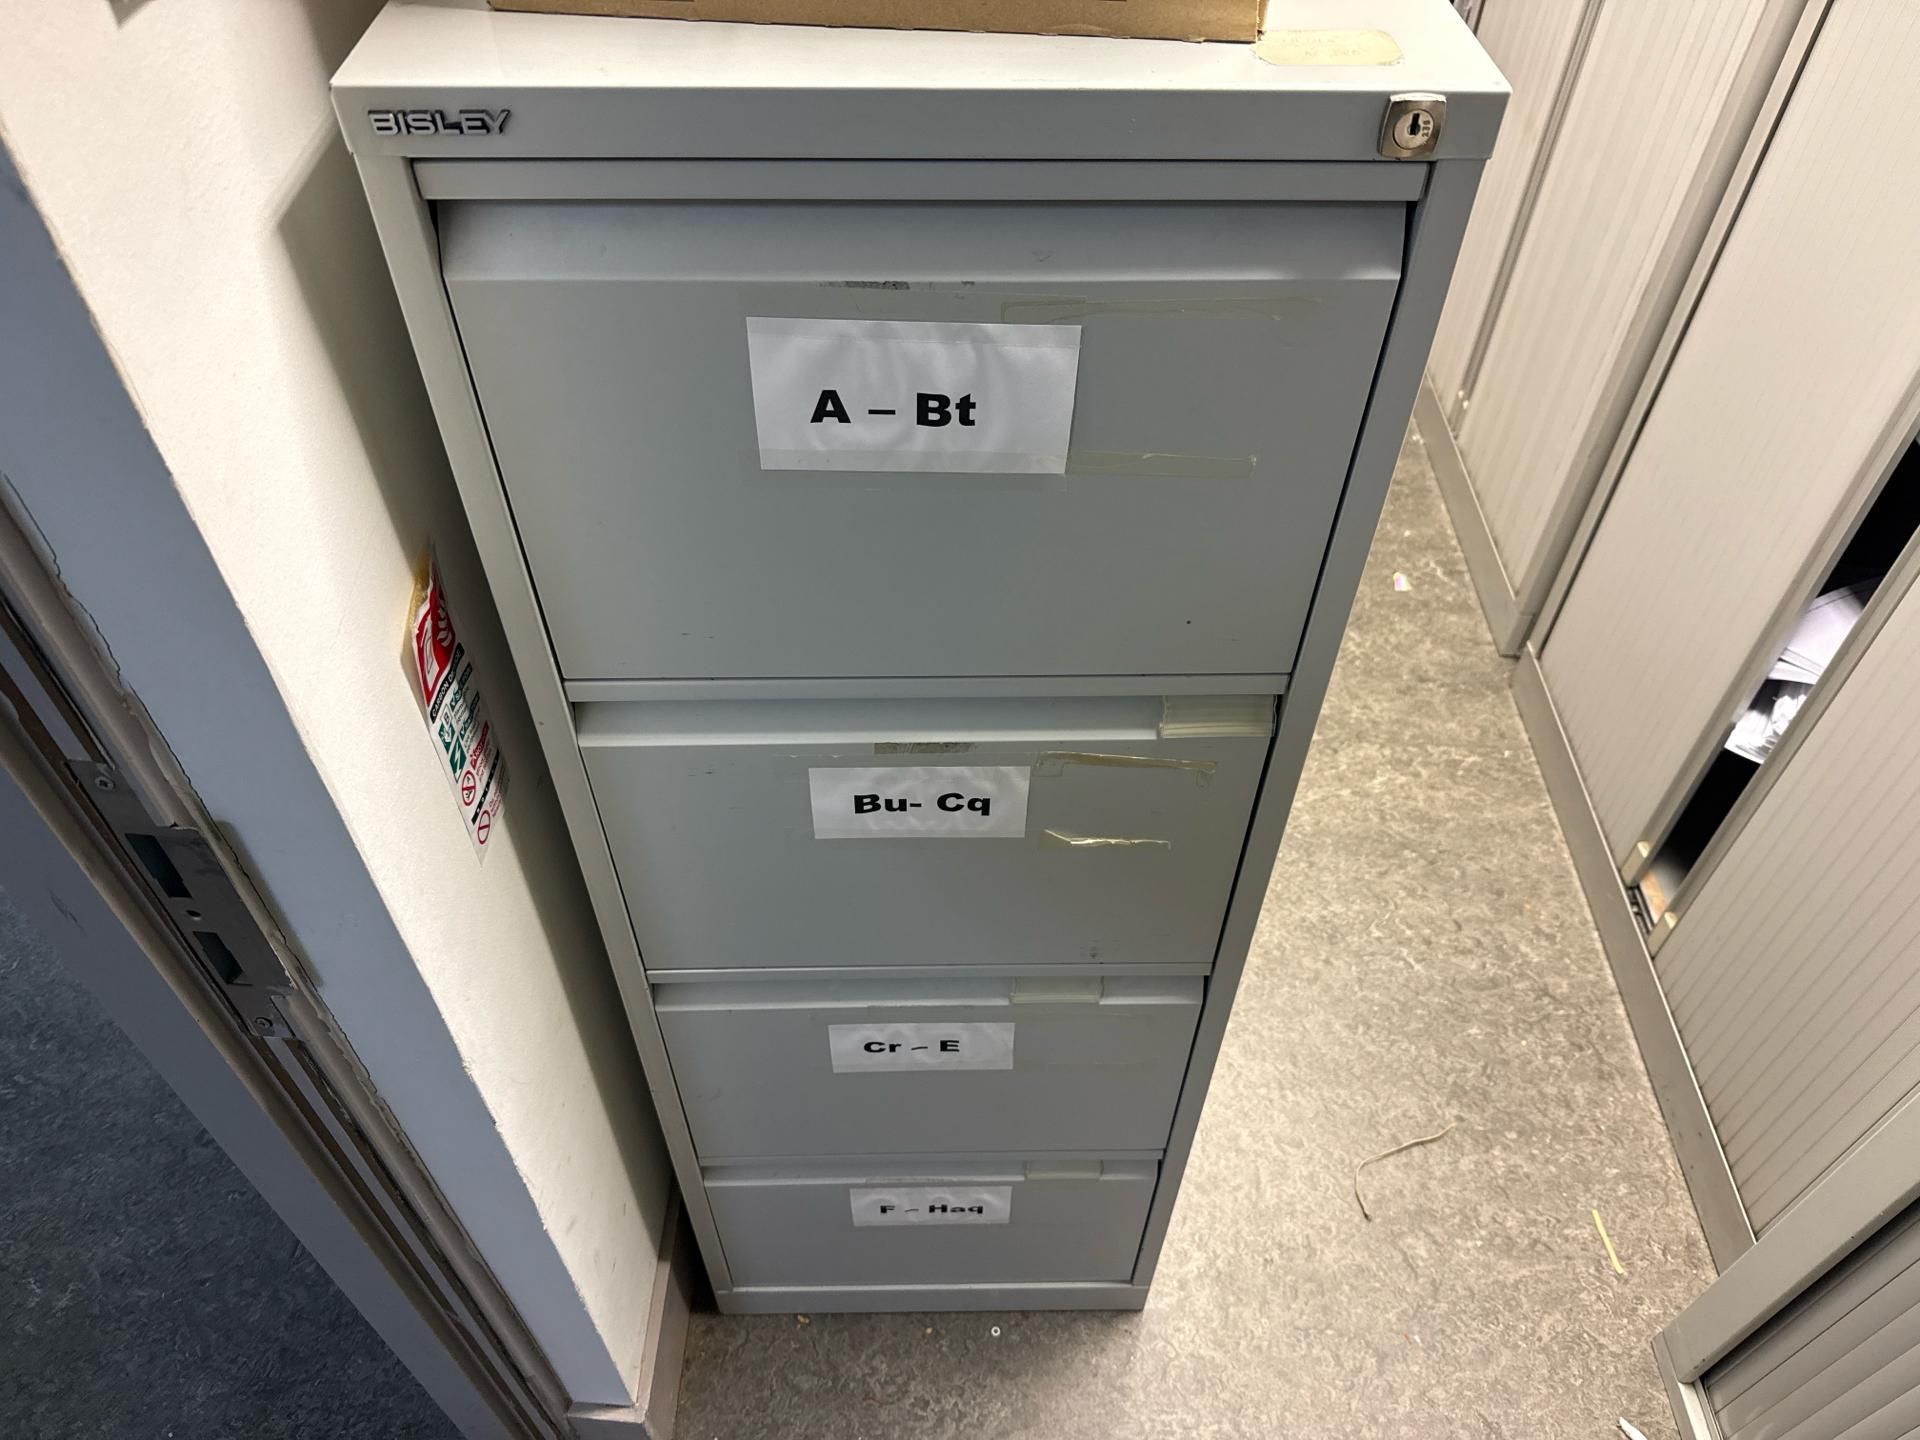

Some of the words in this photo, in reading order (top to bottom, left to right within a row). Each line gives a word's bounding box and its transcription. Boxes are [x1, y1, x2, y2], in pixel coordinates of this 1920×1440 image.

[367, 108, 512, 136] BISLEY
[810, 390, 851, 423] A
[917, 393, 976, 427] Bt
[854, 794, 921, 814] Bu-
[937, 793, 990, 816] Cq
[864, 1042, 901, 1053] Cr
[940, 1040, 959, 1052] E
[880, 1205, 896, 1214] F
